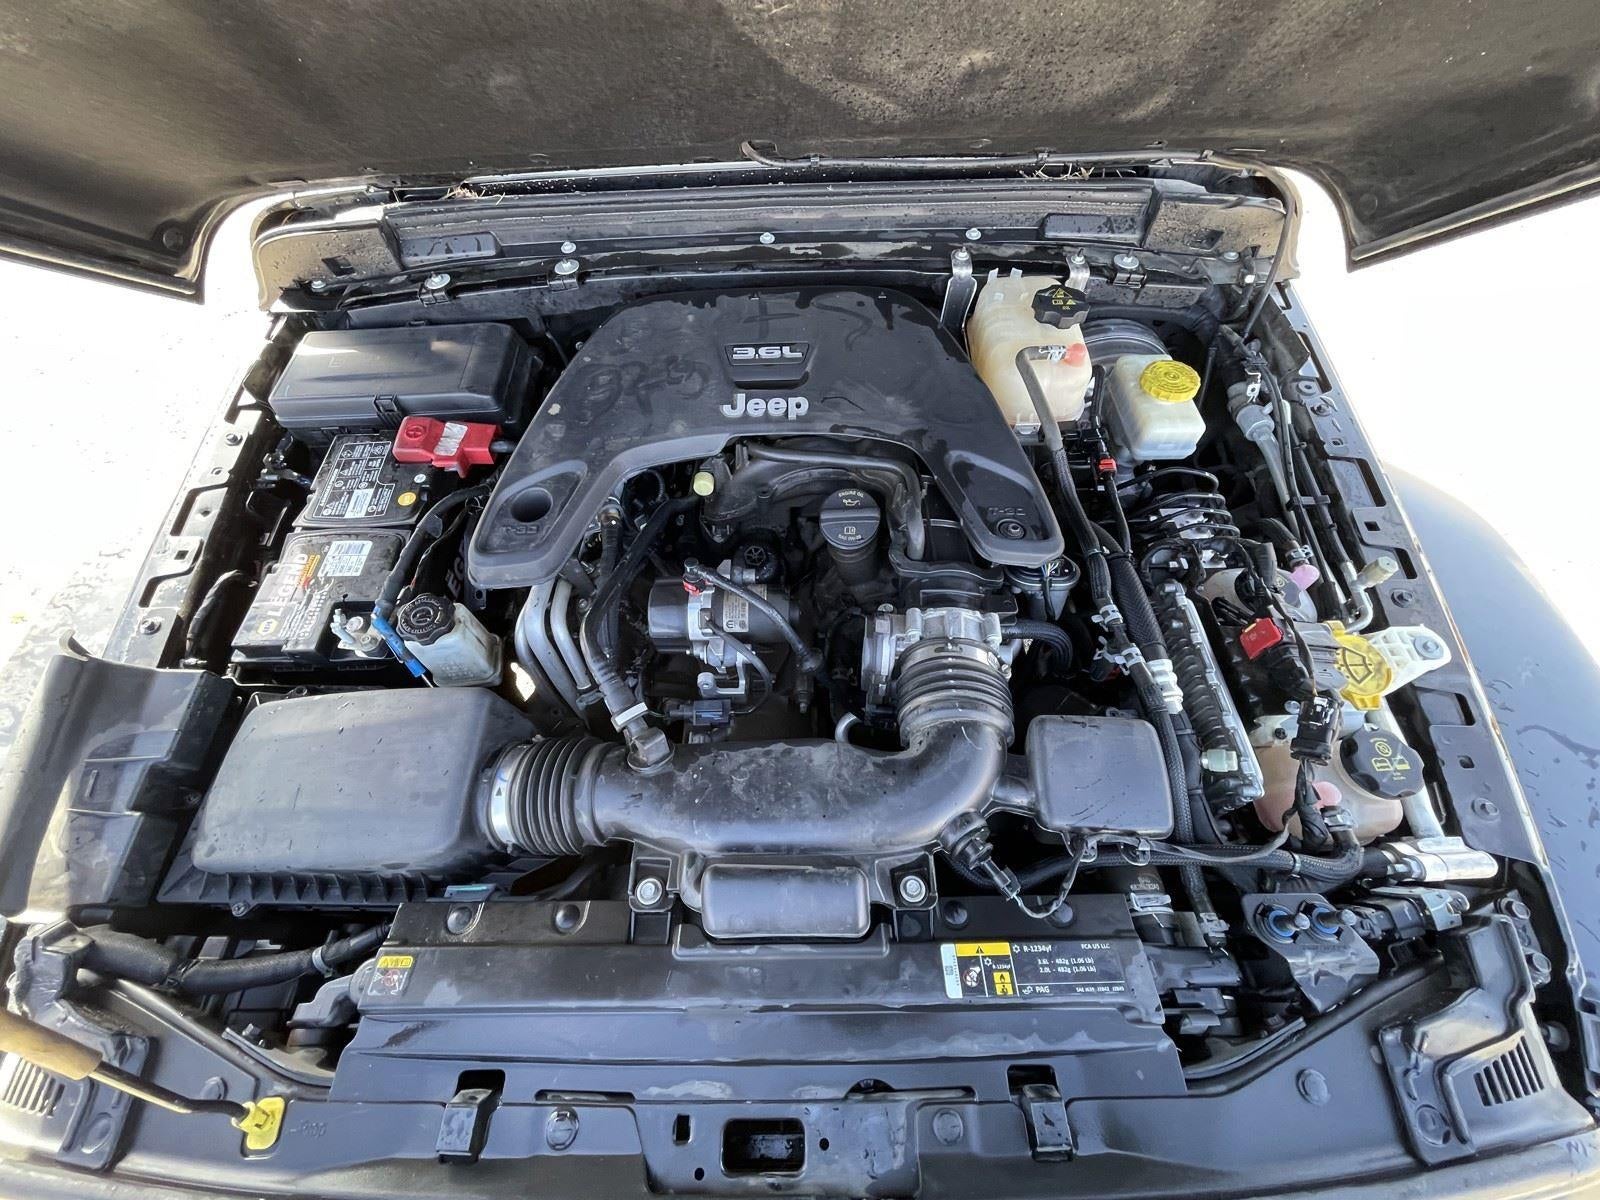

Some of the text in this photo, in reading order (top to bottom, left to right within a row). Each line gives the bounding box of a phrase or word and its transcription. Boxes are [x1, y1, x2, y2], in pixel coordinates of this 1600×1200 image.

[732, 346, 803, 359] 3.6L
[720, 393, 809, 420] Jeep
[267, 553, 308, 616] LEGEND
[1023, 945, 1052, 953] R-1234yf
